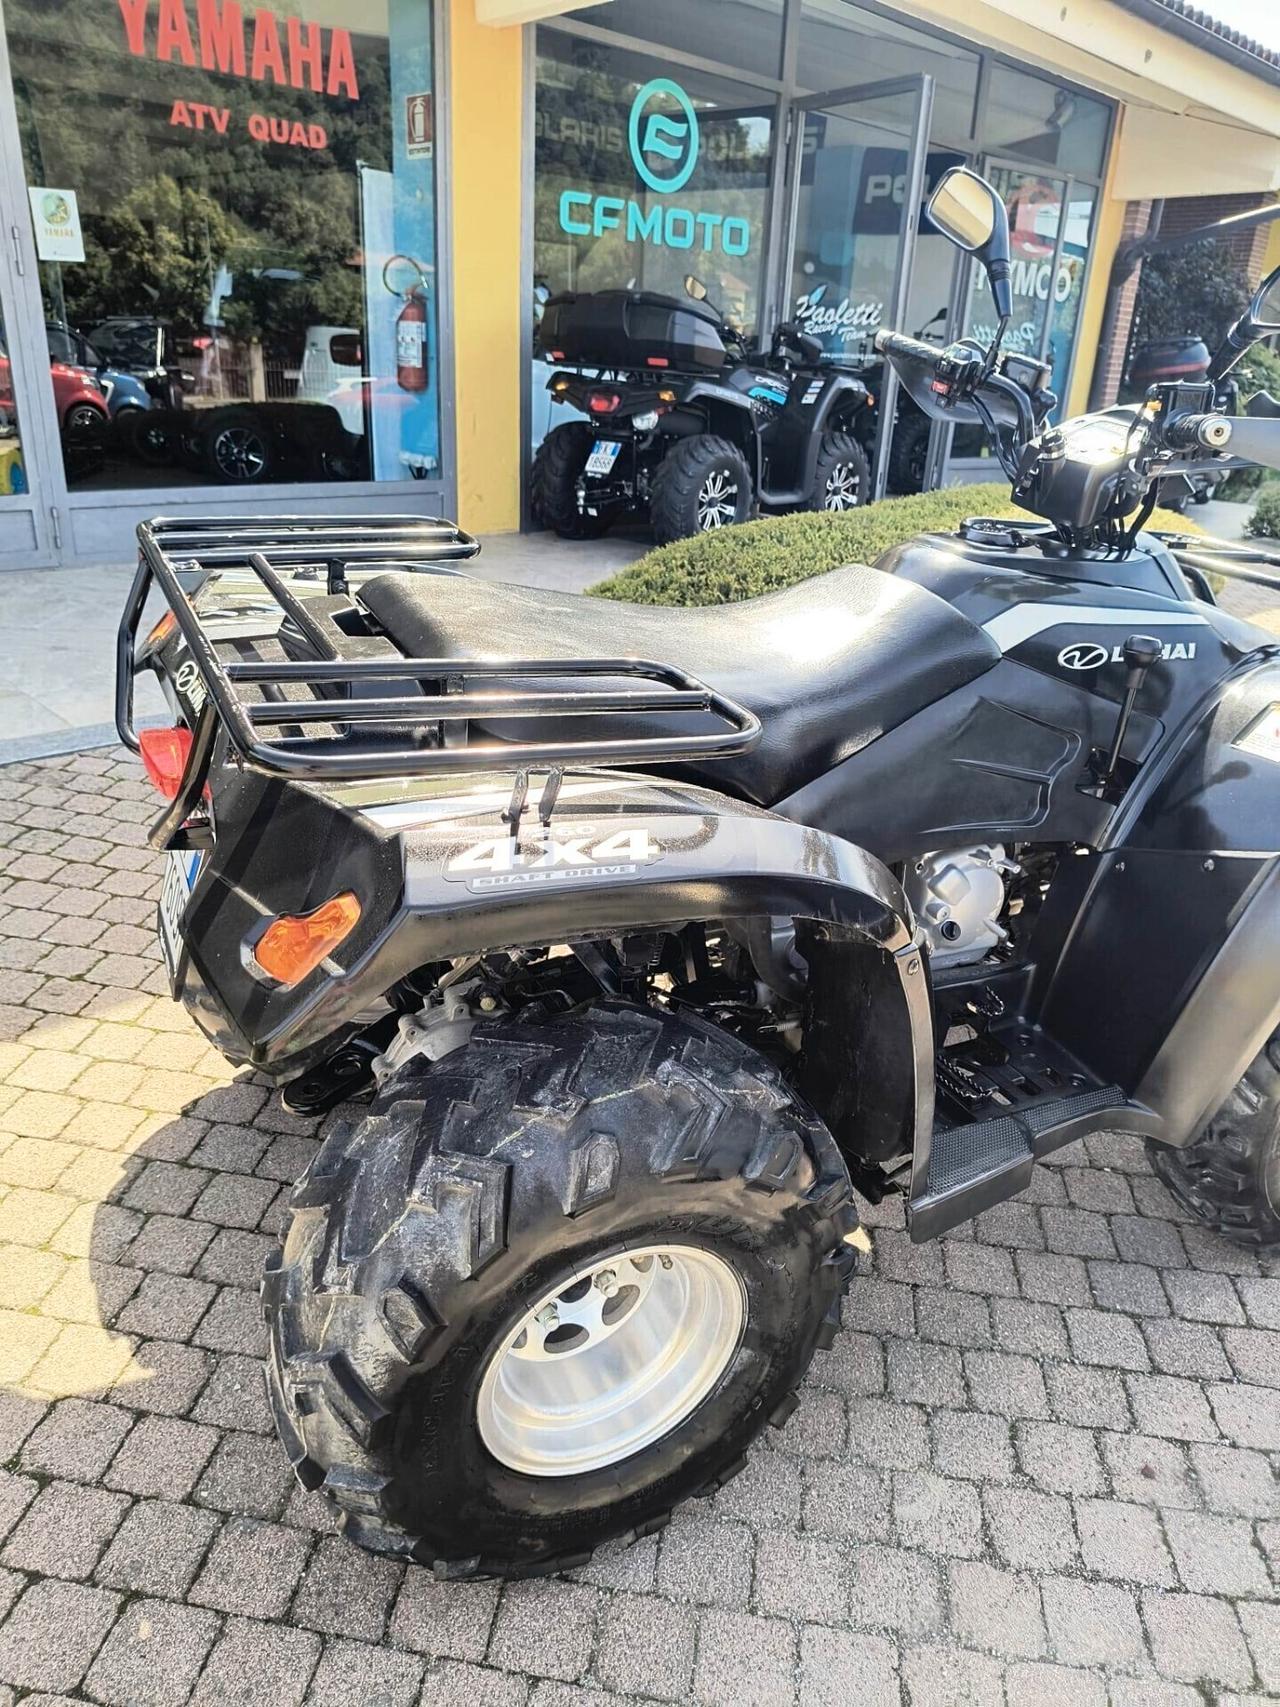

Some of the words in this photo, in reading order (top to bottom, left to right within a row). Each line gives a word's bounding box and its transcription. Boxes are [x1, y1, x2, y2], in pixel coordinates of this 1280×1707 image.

[117, 0, 360, 101] YAMAHA
[170, 99, 231, 134] ATV
[248, 113, 328, 149] QUAD
[558, 190, 751, 257] CFMOTO
[796, 295, 884, 326] Paoletti
[478, 872, 551, 887] SHAFT
[564, 865, 633, 878] DRIVE
